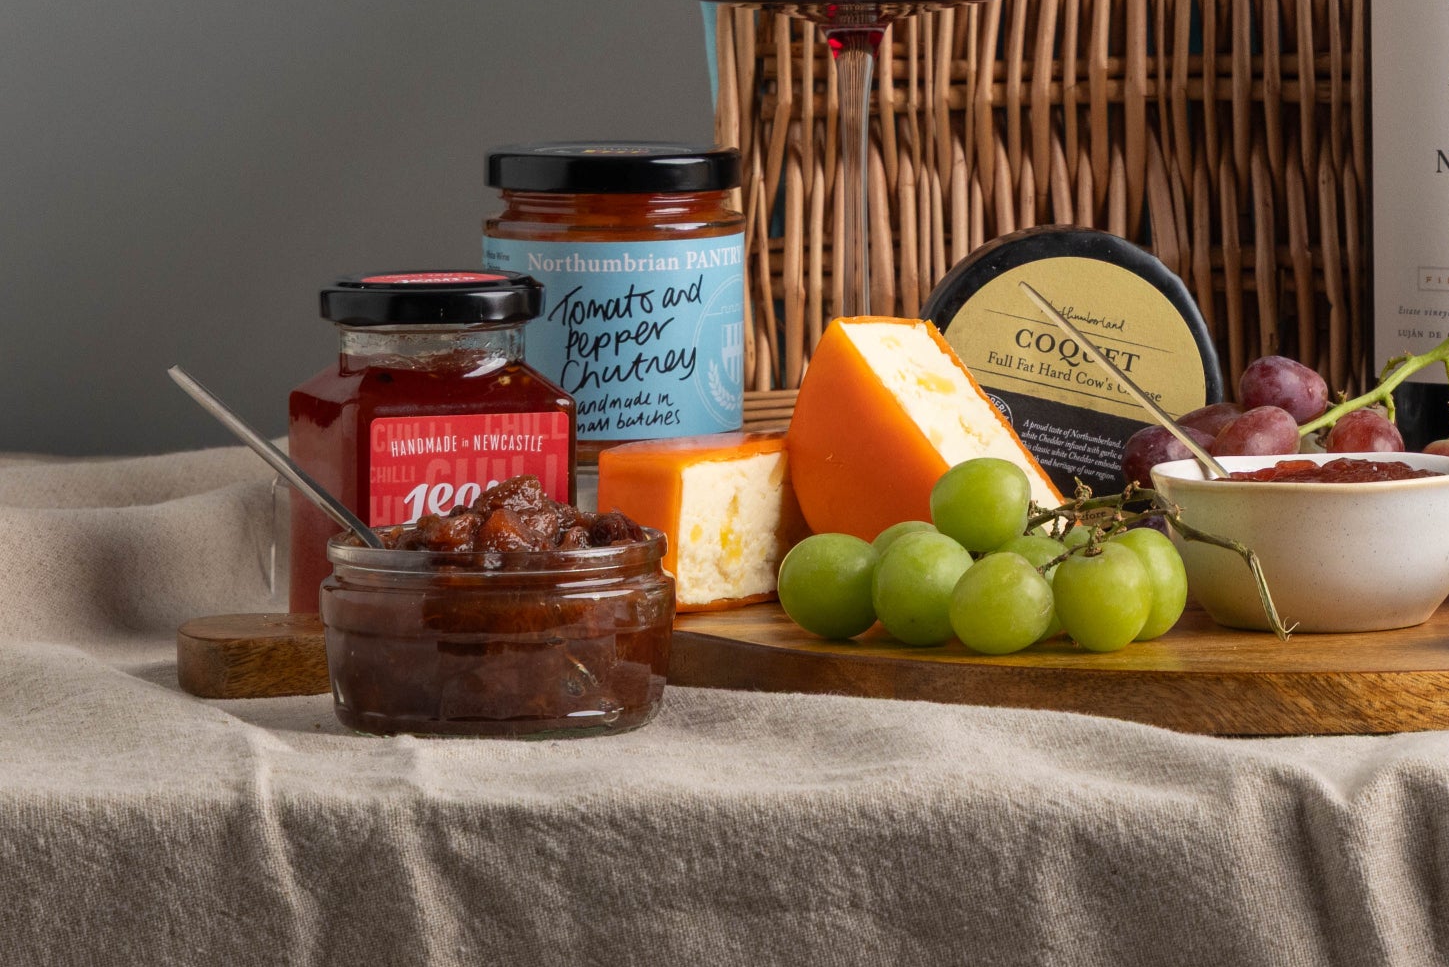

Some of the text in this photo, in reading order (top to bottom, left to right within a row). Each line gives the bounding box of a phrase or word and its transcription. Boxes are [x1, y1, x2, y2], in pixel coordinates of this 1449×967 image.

[527, 252, 680, 273] Northumbrian
[686, 245, 742, 270] PANTRY
[548, 274, 703, 326] Tomato and
[560, 347, 697, 395] Chutney
[987, 351, 1013, 368] Full
[1016, 357, 1035, 373] Fat
[1038, 363, 1072, 382] Hard
[1075, 372, 1113, 391] Cow's
[577, 390, 674, 416] andmade in
[616, 409, 681, 431] batches
[391, 434, 544, 457] HANDMADE in NEWCASTLE
